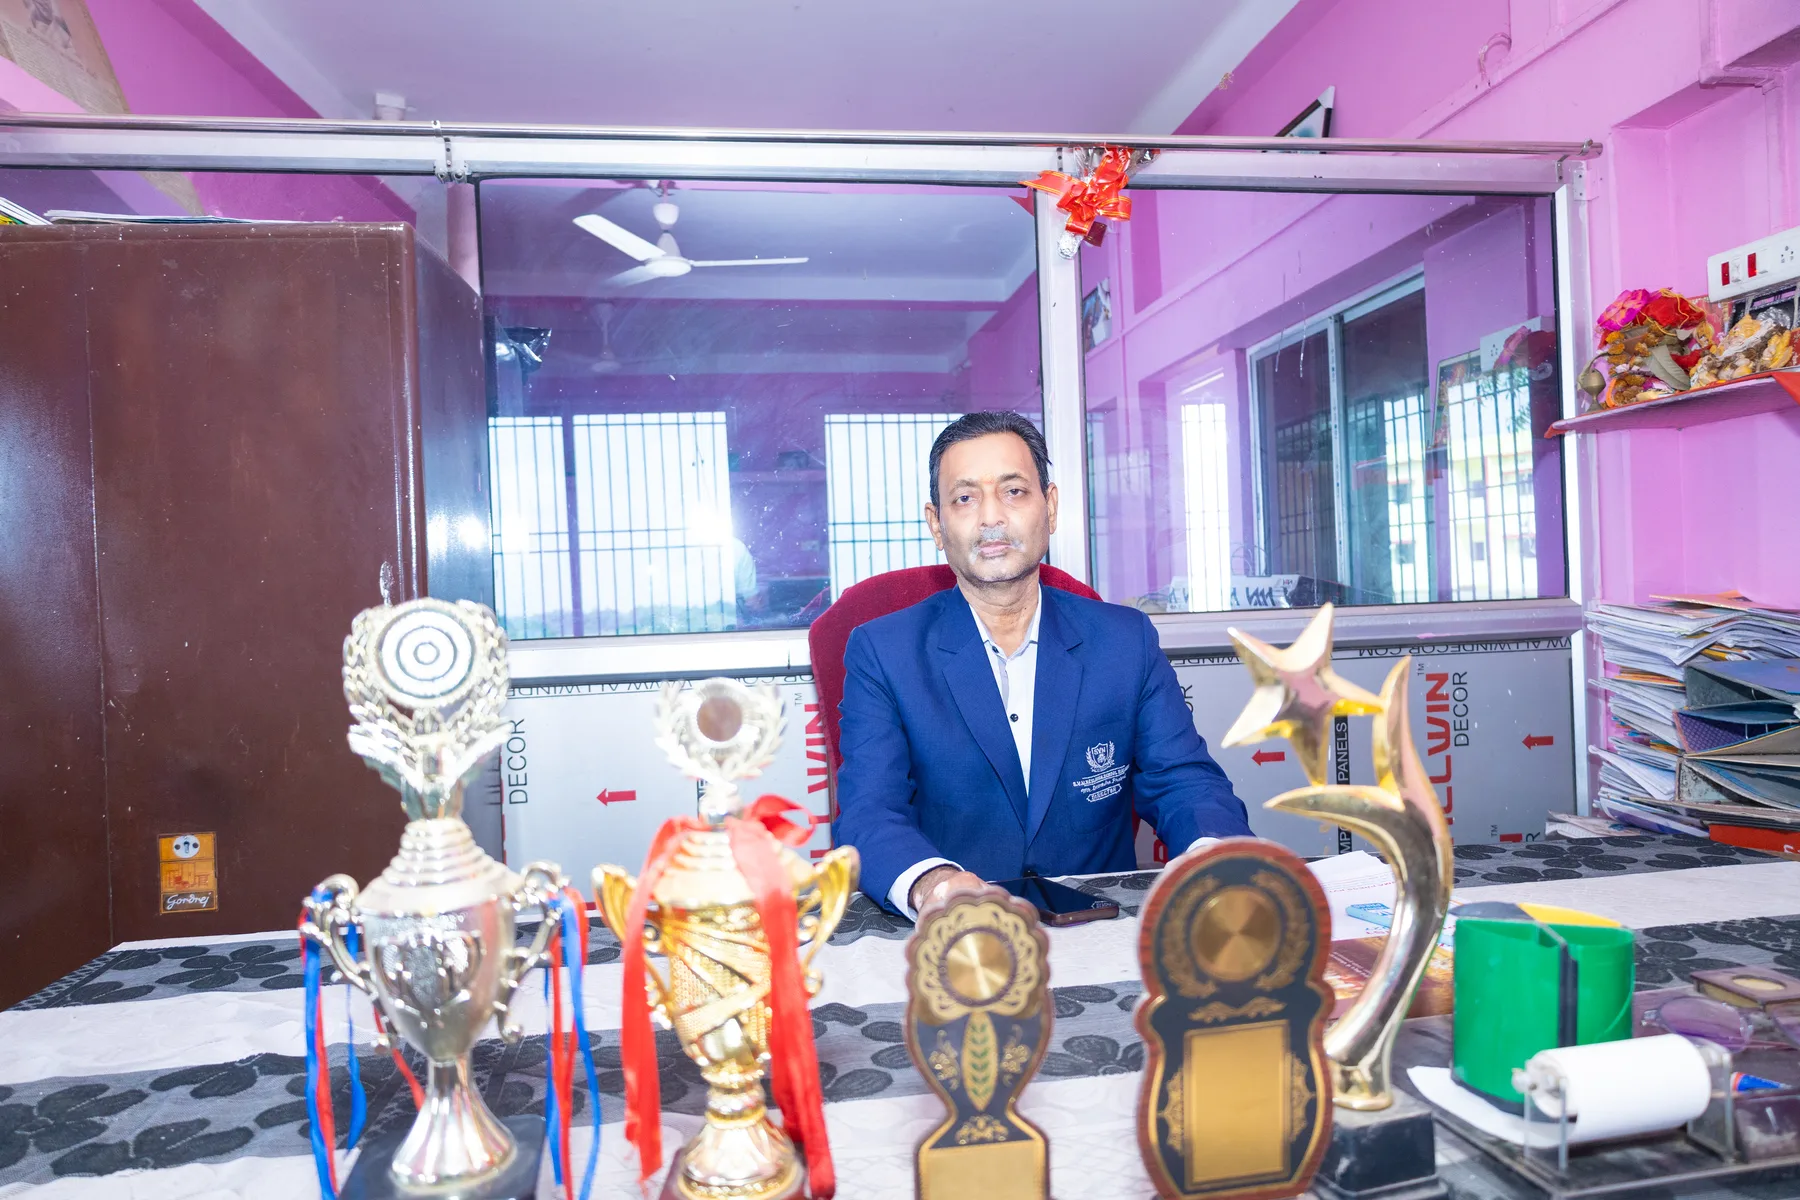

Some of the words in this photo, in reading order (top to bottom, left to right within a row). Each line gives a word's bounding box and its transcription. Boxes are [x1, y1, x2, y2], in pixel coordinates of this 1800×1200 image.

[1452, 672, 1469, 747] DECOR
[506, 718, 528, 805] DECOR
[1335, 722, 1348, 782] PANELS
